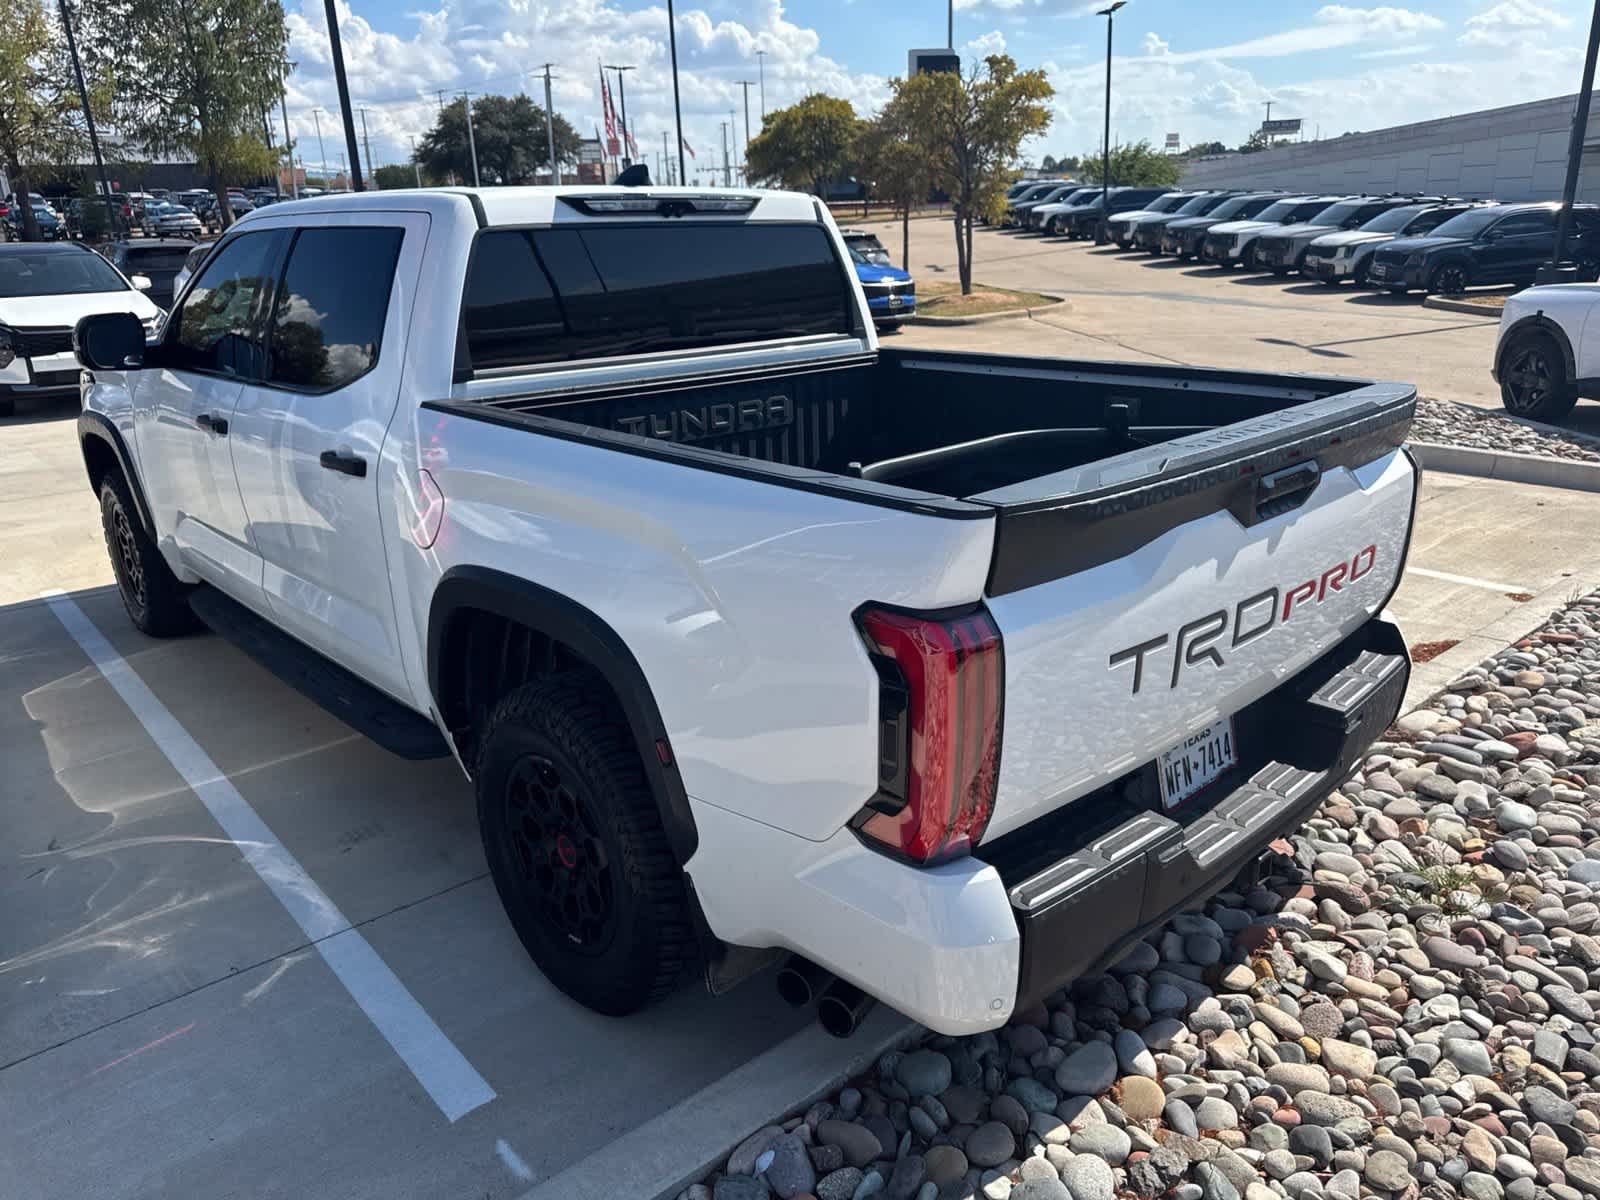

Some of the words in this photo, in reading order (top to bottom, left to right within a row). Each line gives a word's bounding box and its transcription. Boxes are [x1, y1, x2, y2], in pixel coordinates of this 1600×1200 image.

[617, 394, 794, 441] TUNDRA
[1109, 586, 1279, 694] TRD
[1281, 544, 1378, 623] PRO
